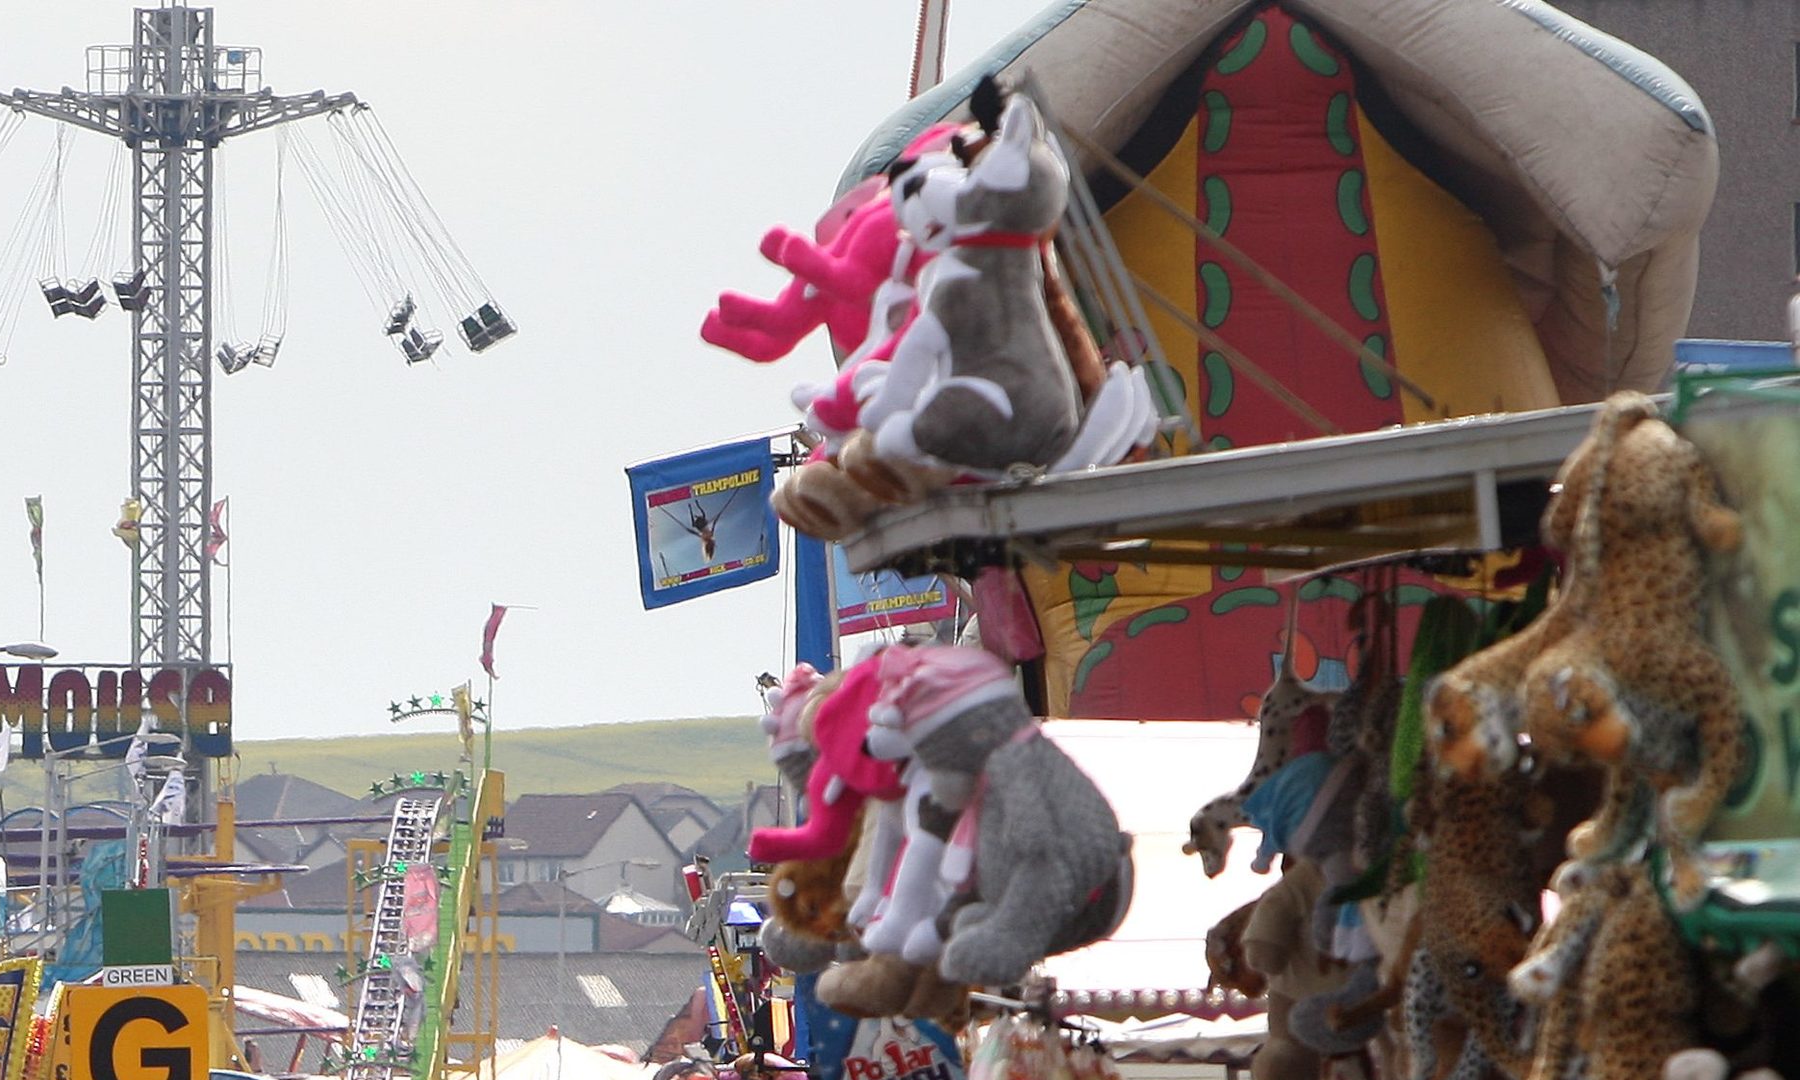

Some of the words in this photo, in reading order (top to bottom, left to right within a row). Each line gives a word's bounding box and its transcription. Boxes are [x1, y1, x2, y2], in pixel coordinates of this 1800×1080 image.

[692, 469, 760, 497] TRAMPOLINE
[868, 591, 941, 612] TRAMPOLINE
[107, 968, 168, 984] GREEN
